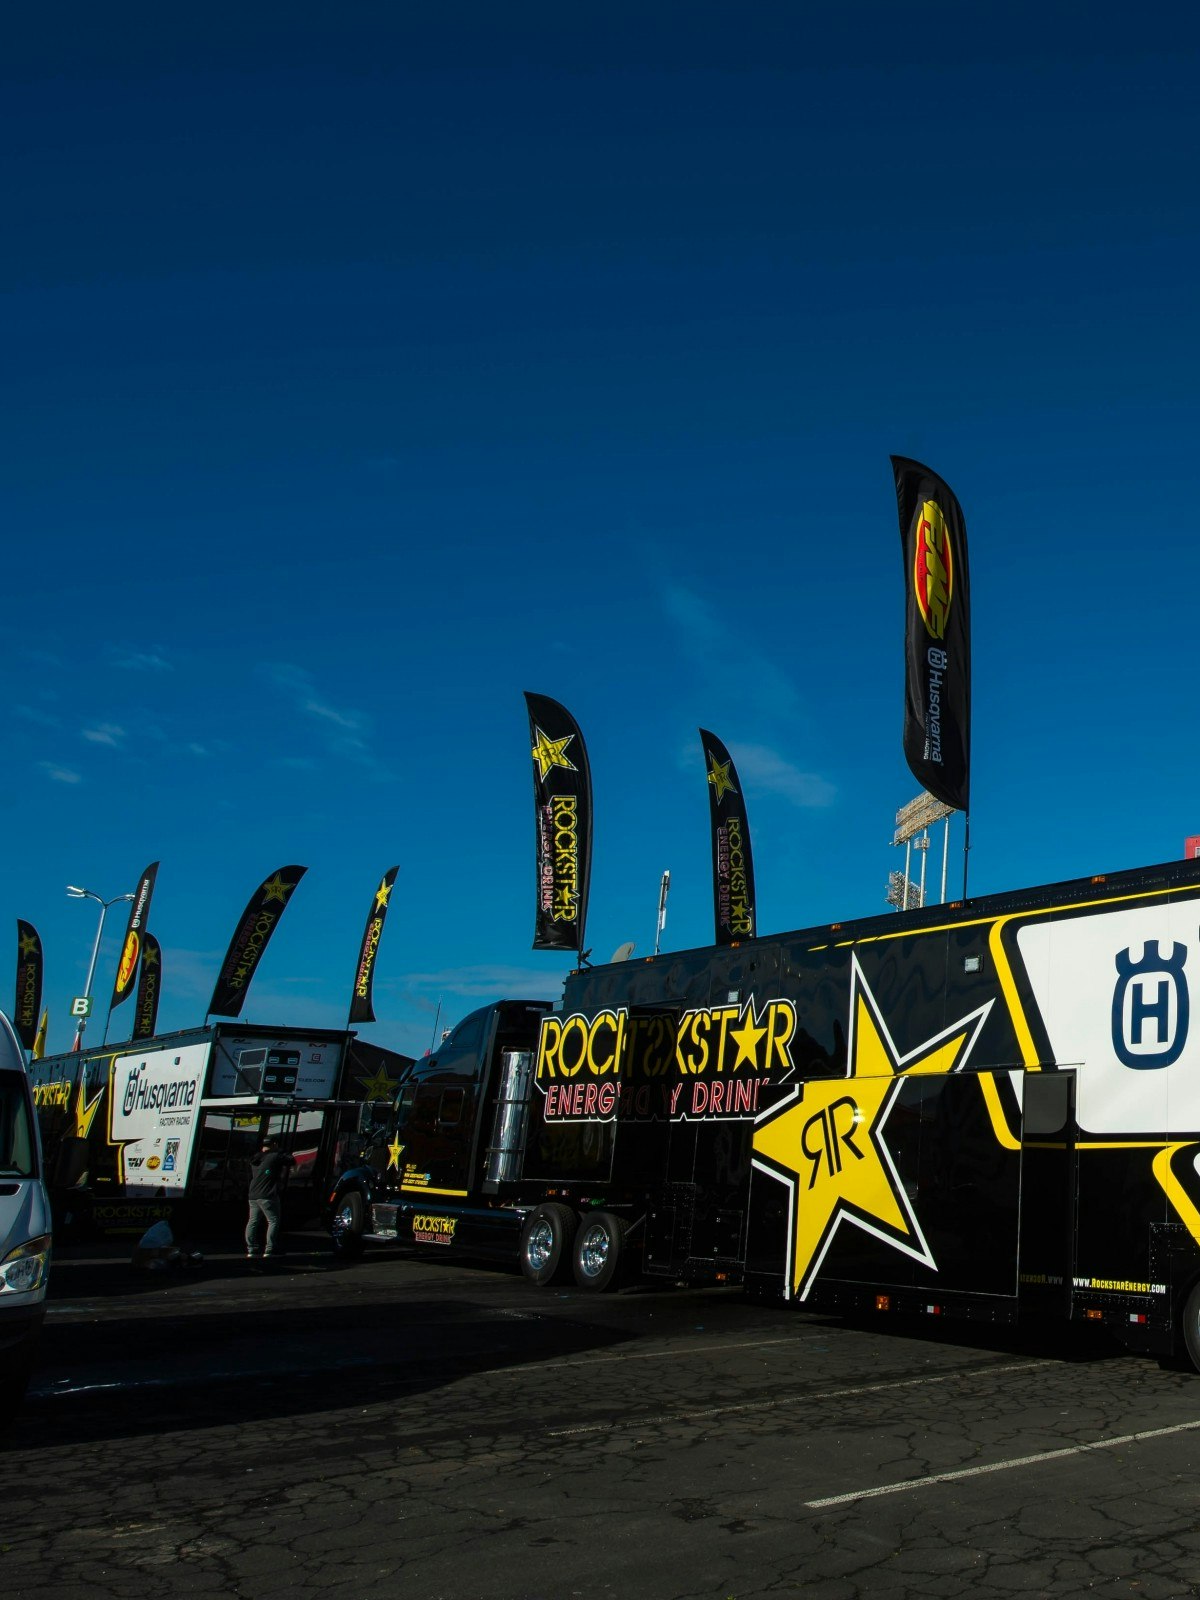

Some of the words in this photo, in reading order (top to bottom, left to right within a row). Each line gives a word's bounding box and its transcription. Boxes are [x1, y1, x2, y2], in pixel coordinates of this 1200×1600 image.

[922, 500, 948, 640] FMF
[926, 671, 945, 766] Husqvarna
[719, 827, 730, 882] ENERGY
[543, 865, 553, 911] DRINK
[720, 884, 732, 927] DRINK
[72, 998, 89, 1015] B
[136, 1078, 197, 1114] Husqvarna
